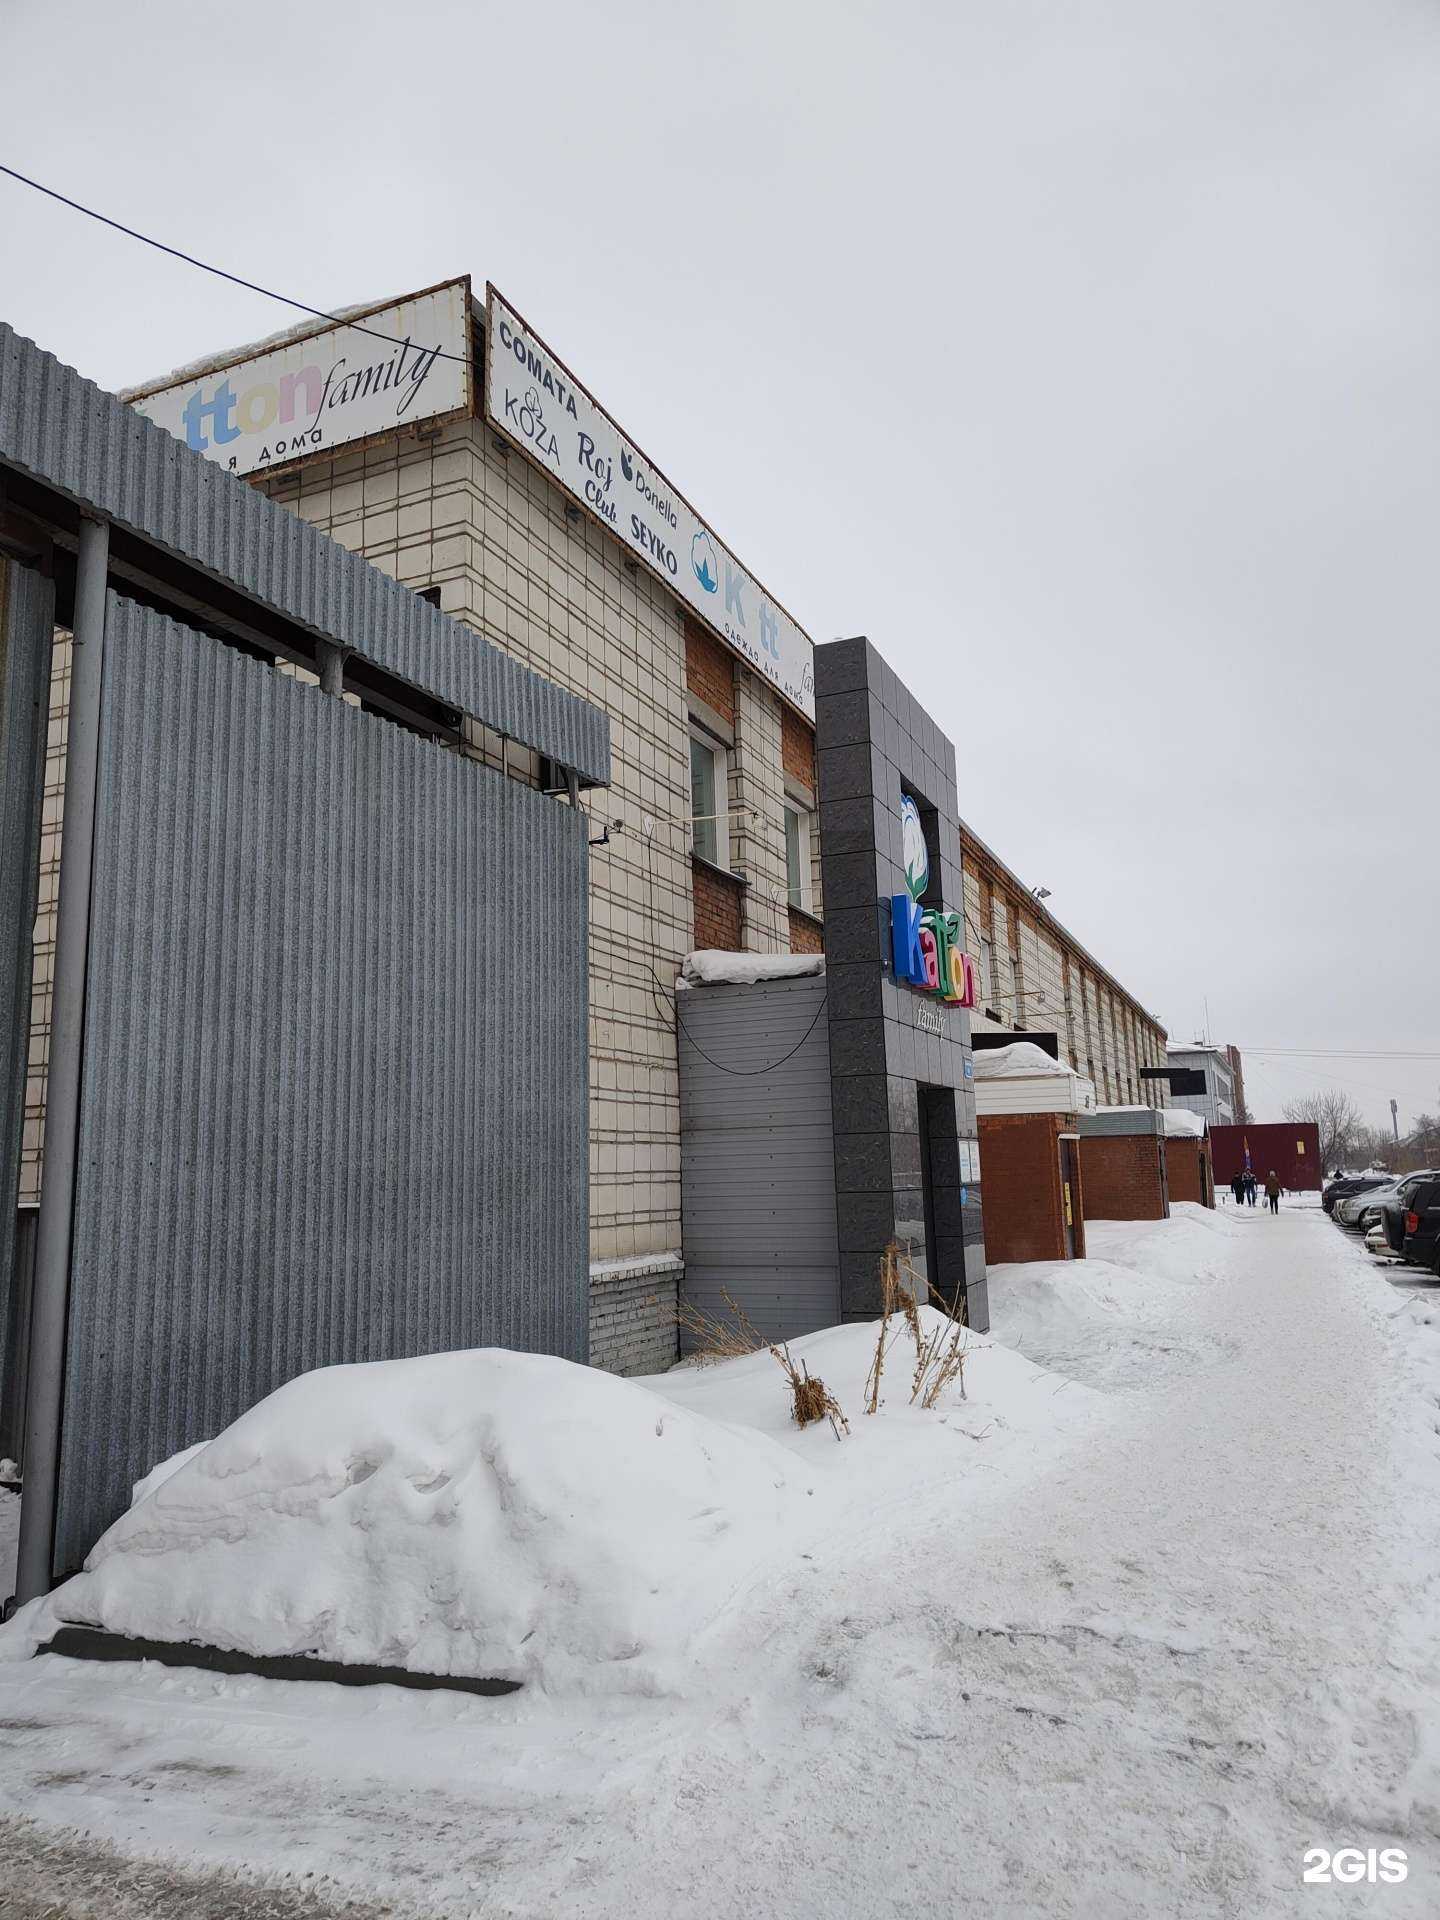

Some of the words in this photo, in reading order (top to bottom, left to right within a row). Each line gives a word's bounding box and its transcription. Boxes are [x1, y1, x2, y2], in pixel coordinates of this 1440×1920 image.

[182, 365, 322, 454] tton
[304, 336, 442, 435] family
[499, 320, 578, 421] COMATA
[259, 428, 322, 462] дома
[505, 388, 560, 466] KOZA
[584, 479, 617, 524] Club
[630, 513, 678, 575] SEYKO
[916, 999, 946, 1042] family
